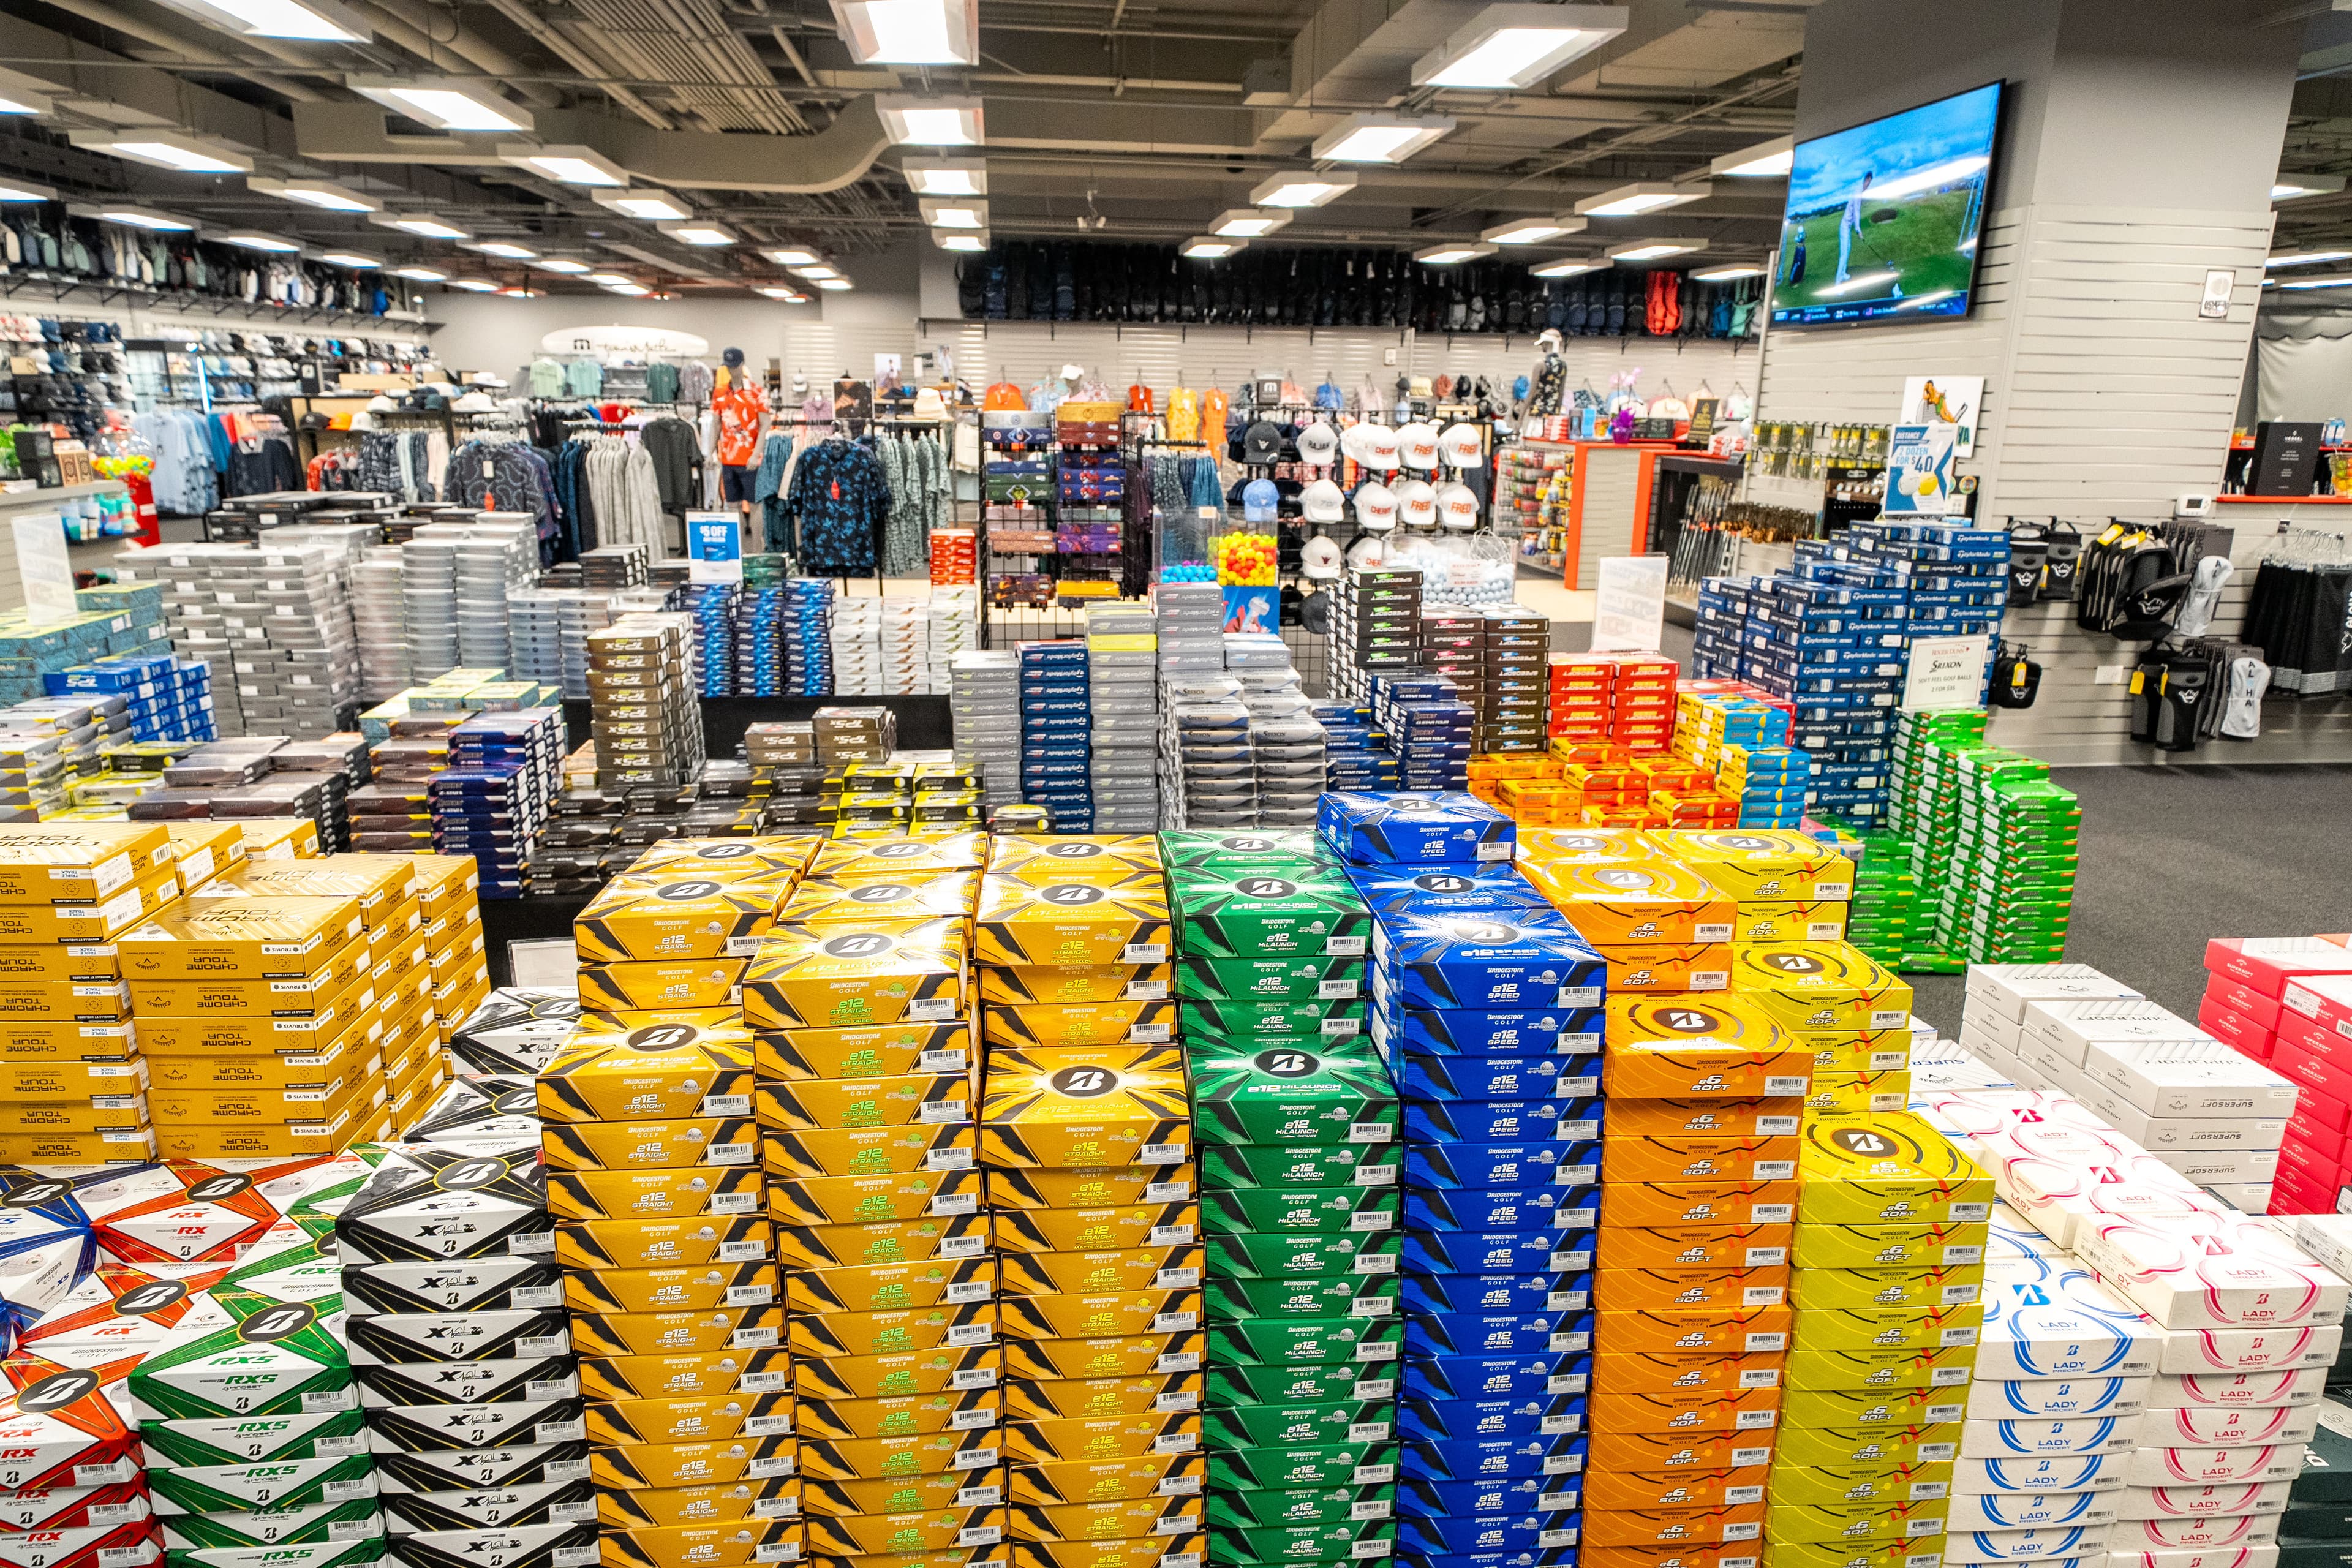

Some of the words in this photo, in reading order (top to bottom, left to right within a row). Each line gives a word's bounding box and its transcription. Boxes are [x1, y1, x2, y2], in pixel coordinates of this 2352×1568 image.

[1912, 456, 1933, 472] $40
[1411, 500, 1431, 511] FRED
[1451, 502, 1472, 513] FRED
[710, 526, 728, 537] OFF
[1929, 660, 1962, 673] SRIXON
[662, 935, 685, 944] e12
[2227, 963, 2253, 976] SUPERSOFT
[1493, 983, 1517, 993] e12
[839, 998, 864, 1009] e12
[2228, 995, 2252, 1009] SUPERSOFT
[2042, 1028, 2064, 1044] SUPERSOFT
[2303, 1036, 2332, 1052] SUPERSOFT
[2107, 1071, 2132, 1090] SUPERSOFT
[631, 1094, 658, 1104] e12
[1285, 1120, 1310, 1128] e12
[1073, 1142, 1098, 1151] e12
[2053, 1361, 2086, 1370] LADY
[225, 1374, 278, 1385] RXS
[237, 1421, 291, 1432] RXS
[1, 1448, 40, 1458] RX
[27, 1532, 66, 1542] RX
